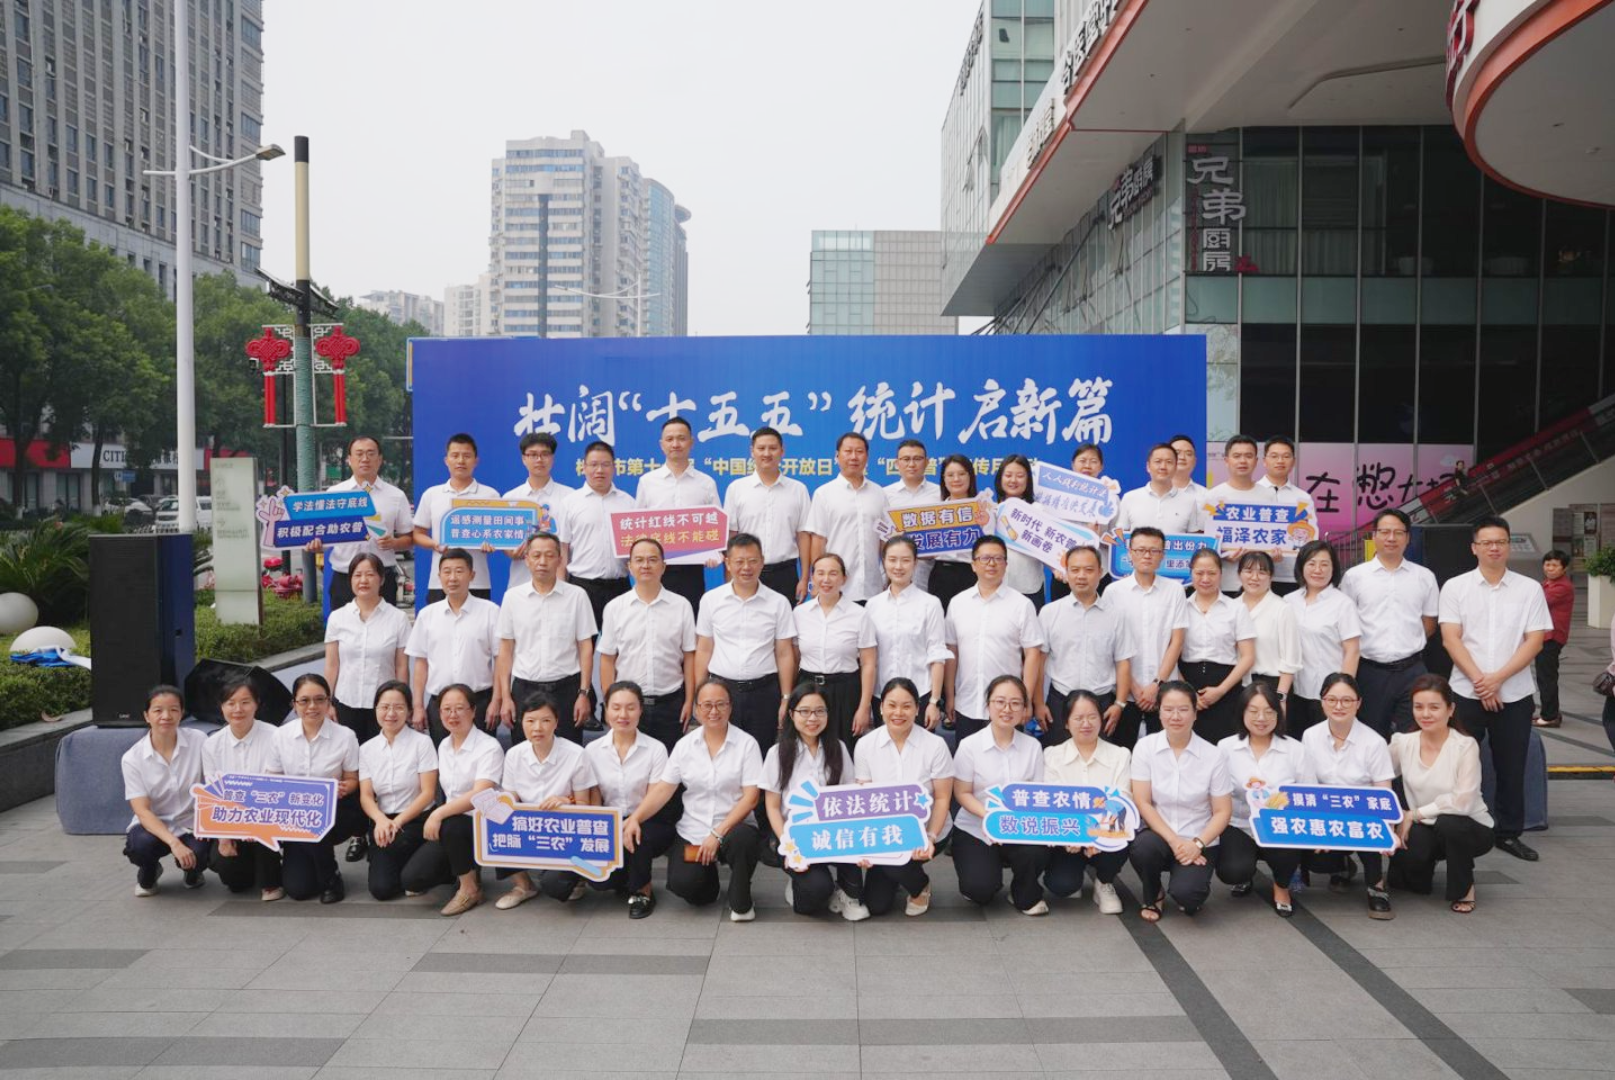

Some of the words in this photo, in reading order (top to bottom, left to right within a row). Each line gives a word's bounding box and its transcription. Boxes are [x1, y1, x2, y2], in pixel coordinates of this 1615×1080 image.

[1187, 156, 1247, 272] 兄弟厨房
[292, 496, 368, 512] 学法懂法守底线
[1225, 506, 1290, 523] 农业普查
[620, 511, 719, 531] 统计红线不可越
[901, 505, 973, 527] 数据有信
[1010, 508, 1043, 532] 新时代
[276, 521, 363, 539] 积极配合助农普
[1021, 529, 1054, 553] 新画卷
[1217, 526, 1287, 546] 福泽农家
[822, 790, 914, 818] 依法统计
[1012, 789, 1091, 810] 普查农情
[211, 805, 323, 828] 助力农业现代化
[511, 816, 609, 836] 搞好农业普查
[999, 814, 1081, 837] 数说振兴
[811, 824, 904, 851] 诚信有我
[1270, 816, 1385, 840] 强农惠农富农
